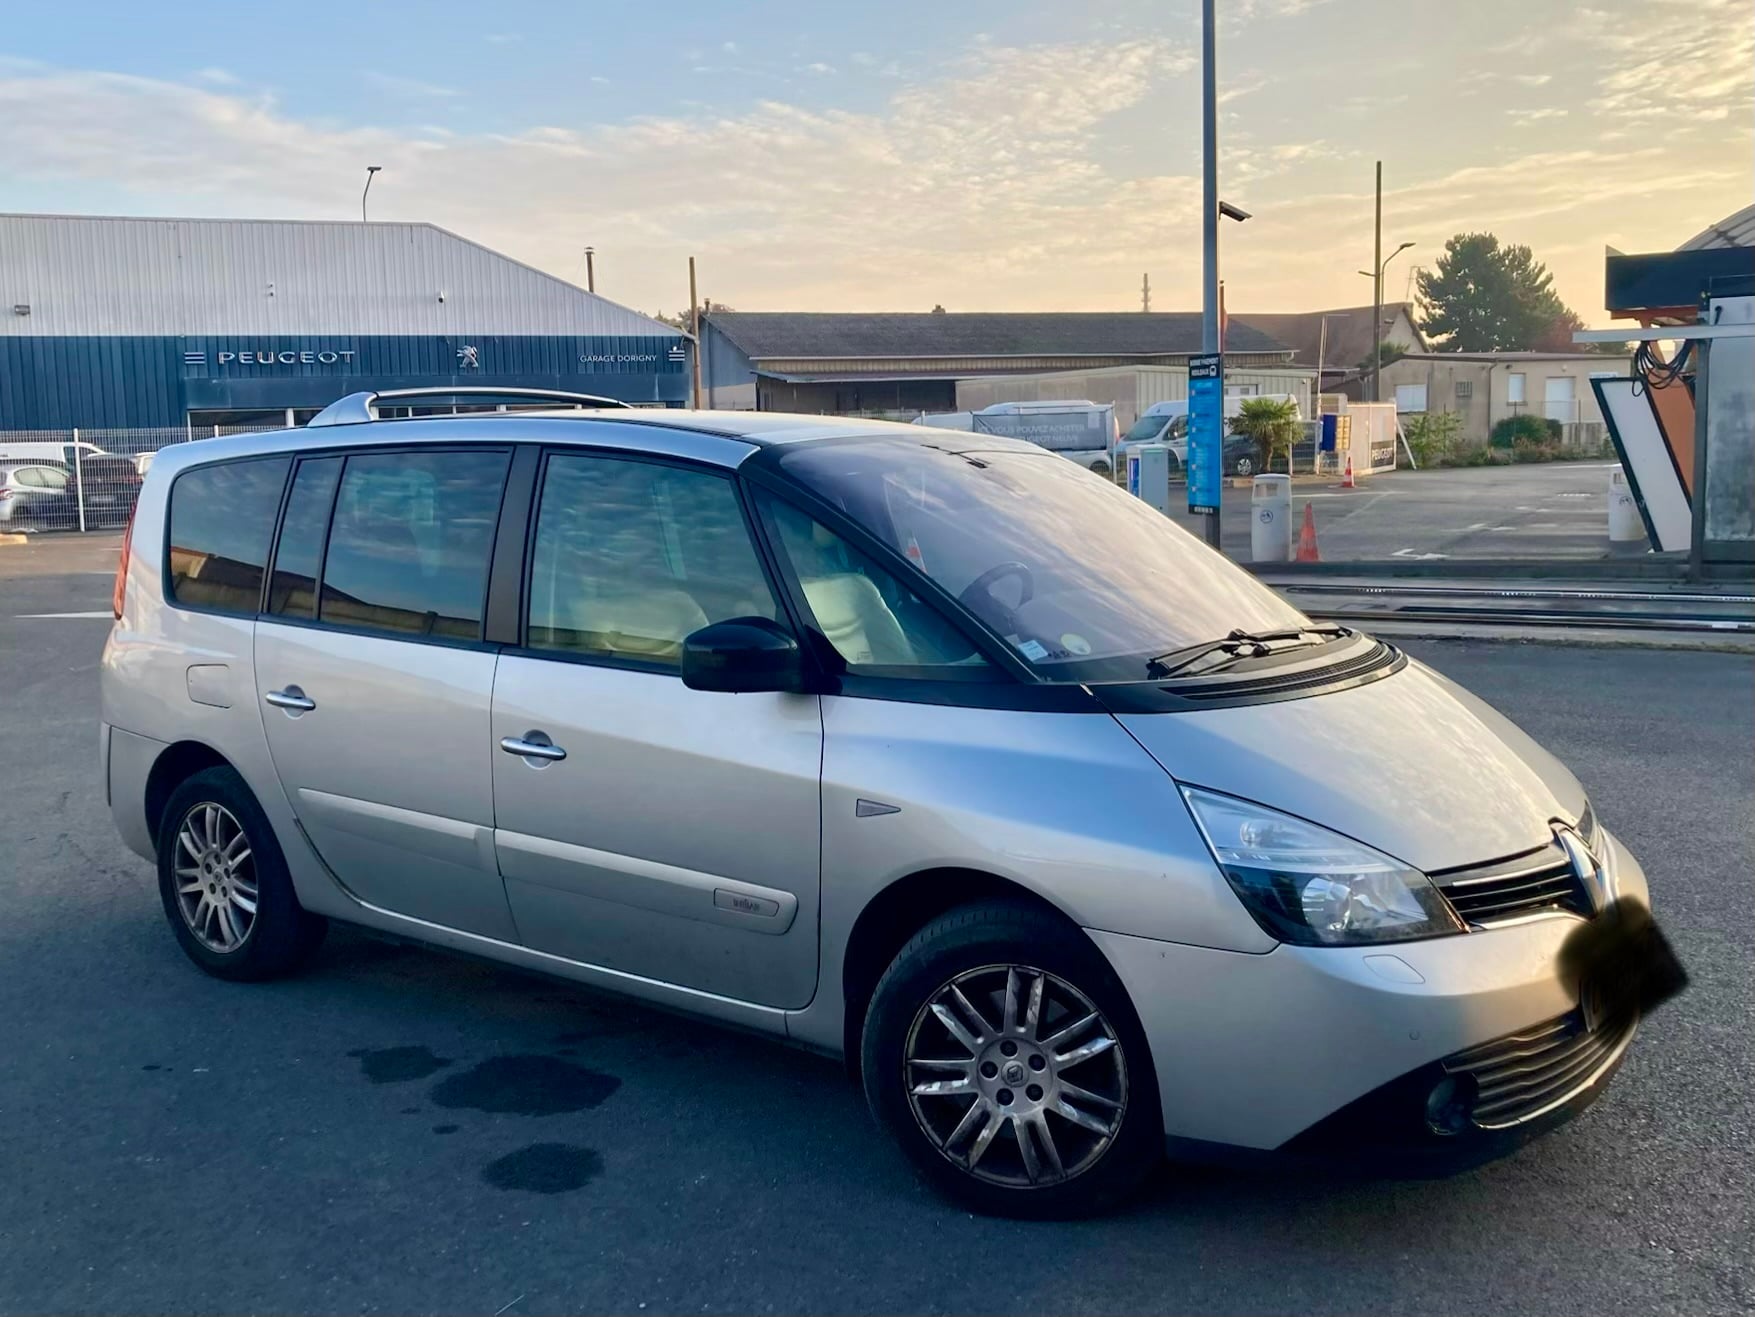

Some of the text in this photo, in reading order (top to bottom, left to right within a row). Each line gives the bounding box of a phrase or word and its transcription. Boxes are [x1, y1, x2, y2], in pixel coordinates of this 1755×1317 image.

[218, 351, 355, 364] PEUGEOT
[580, 354, 657, 363] GARAGE DORIGNY
